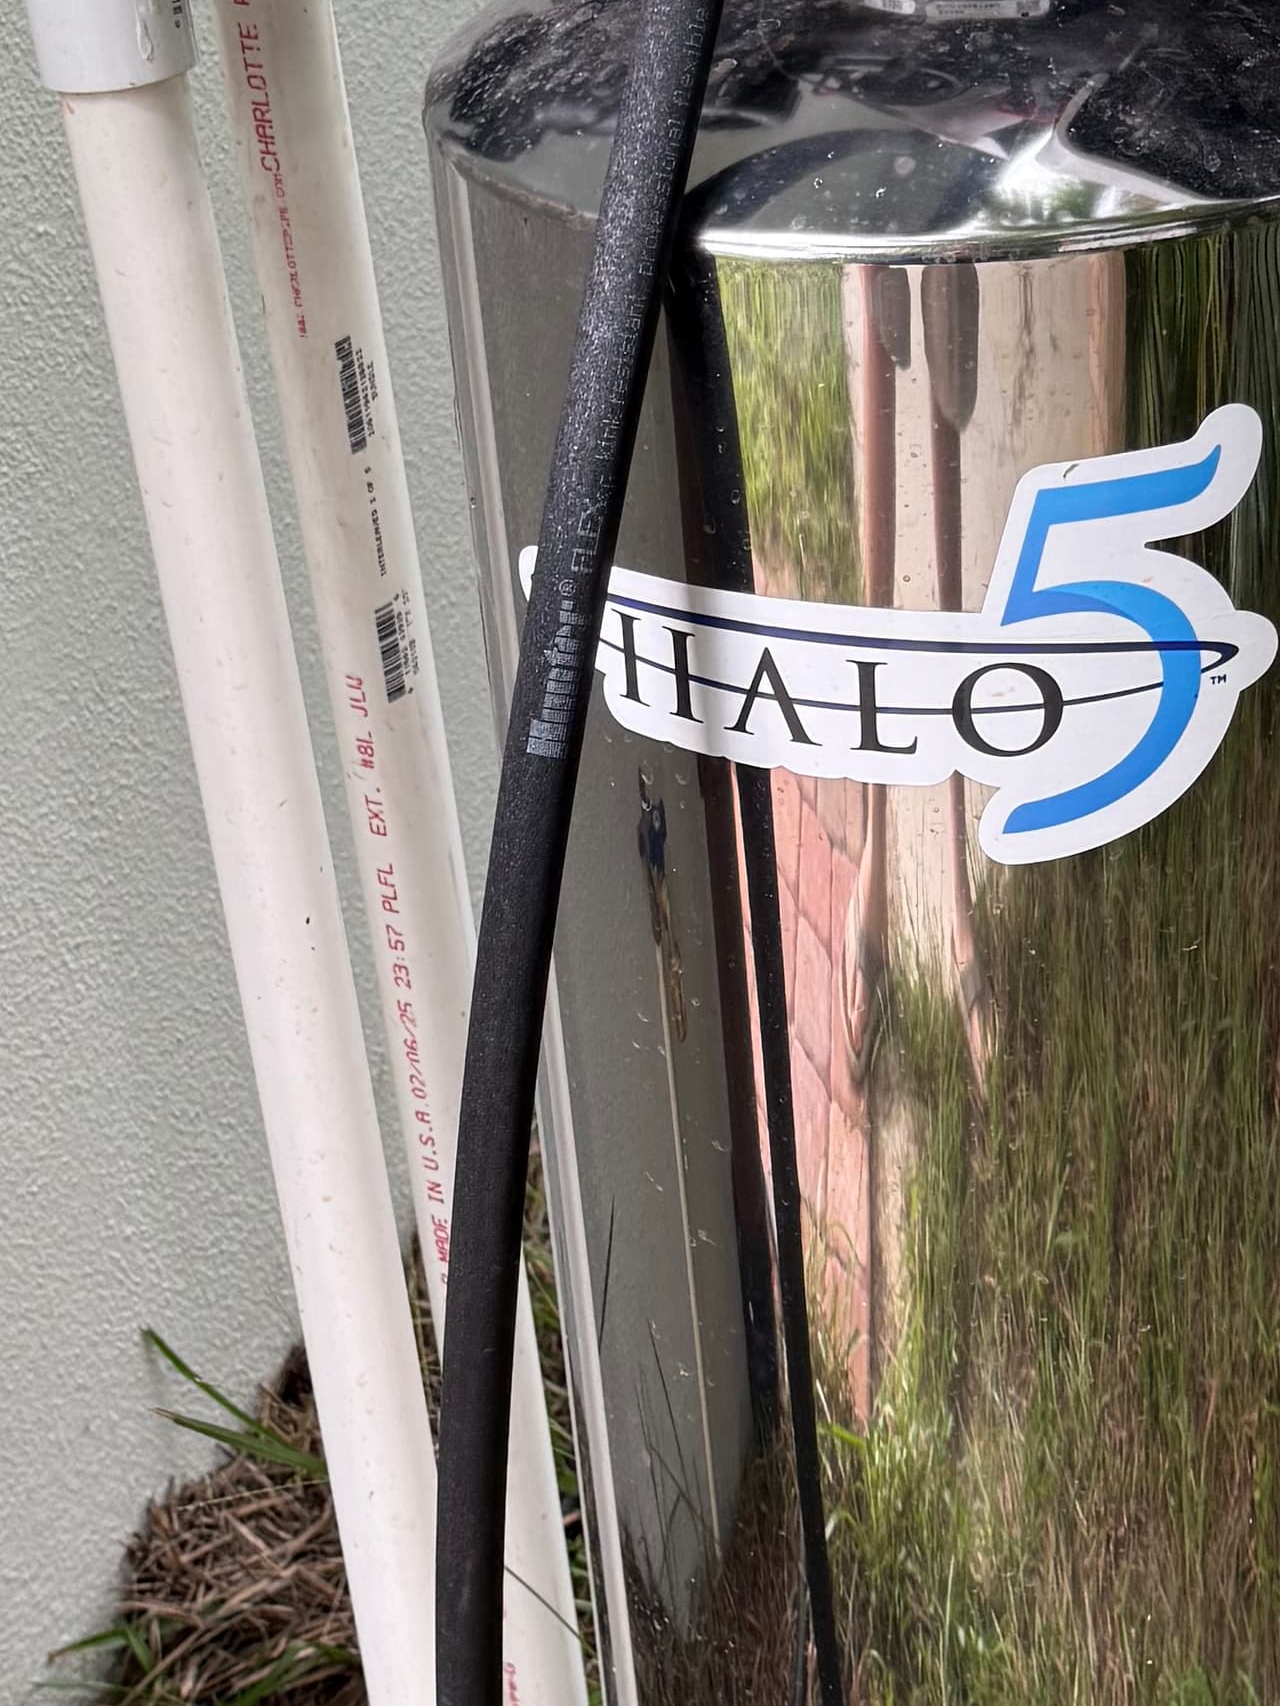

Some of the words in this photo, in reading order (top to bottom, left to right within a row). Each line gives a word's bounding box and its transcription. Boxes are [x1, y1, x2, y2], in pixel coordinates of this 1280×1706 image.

[237, 22, 281, 173] CHARLOTTE
[610, 610, 1064, 758] HALO
[1001, 443, 1222, 835] 5
[364, 786, 388, 837] EXT.
[377, 862, 400, 914] PLFL
[385, 924, 413, 990] 23:57
[426, 1181, 445, 1205] IN
[431, 1215, 450, 1265] MADE
